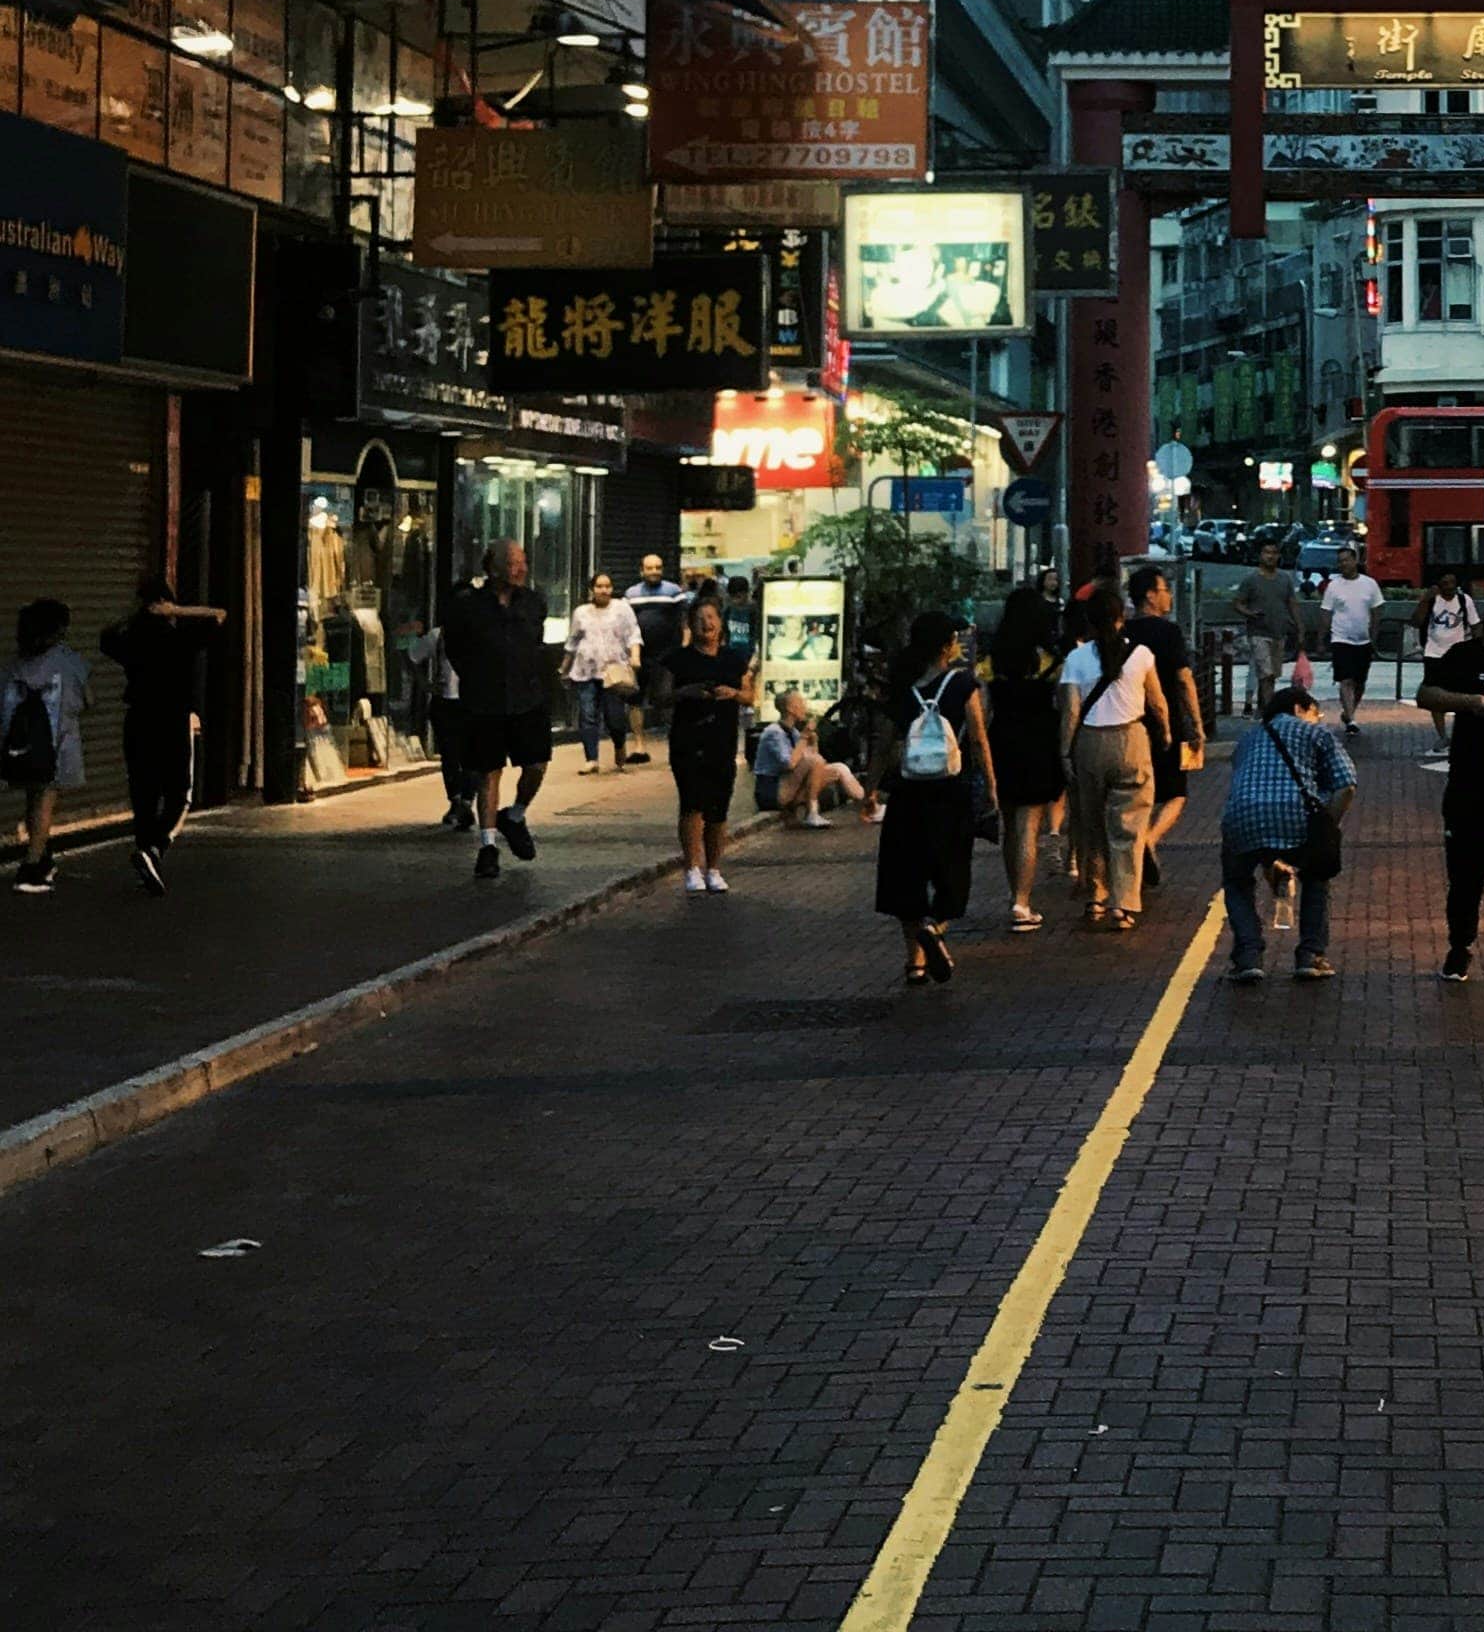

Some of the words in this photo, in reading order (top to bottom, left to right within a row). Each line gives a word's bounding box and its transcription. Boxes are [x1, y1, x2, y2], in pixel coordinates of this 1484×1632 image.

[815, 71, 920, 95] HOSTEL
[1374, 69, 1433, 82] Temple
[94, 233, 126, 276] Way
[498, 289, 757, 360] 龍將洋服
